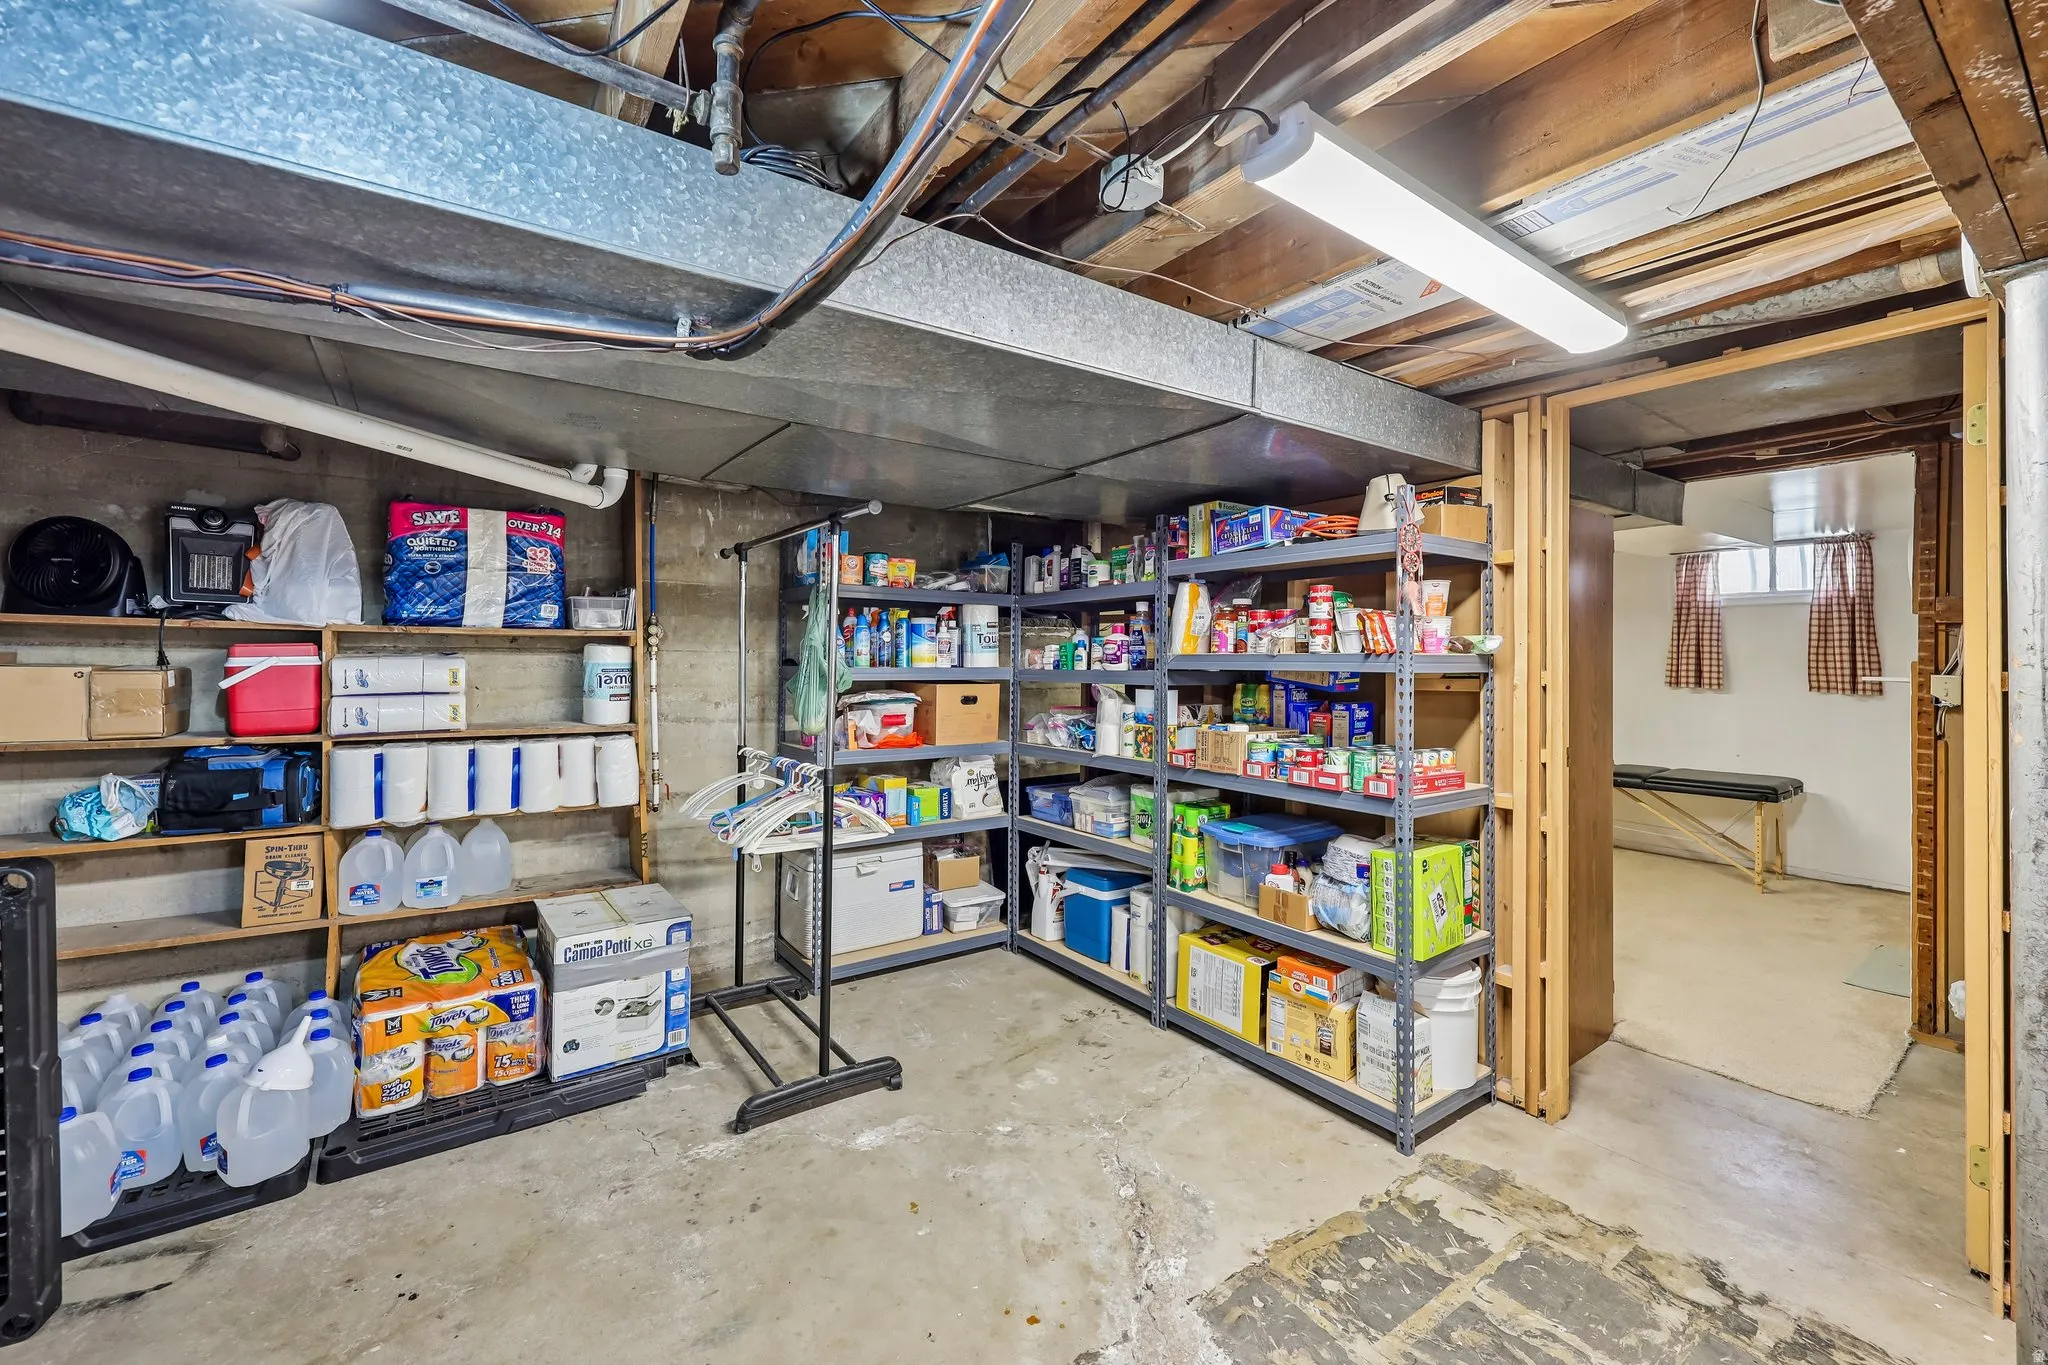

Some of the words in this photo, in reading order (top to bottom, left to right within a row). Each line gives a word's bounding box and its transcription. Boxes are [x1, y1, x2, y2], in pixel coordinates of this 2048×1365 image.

[411, 509, 461, 526] SAVE
[507, 519, 540, 533] OVER
[406, 536, 458, 548] QUILTED
[412, 545, 453, 553] NORTHERN
[528, 547, 549, 561] 32
[597, 673, 632, 689] owel
[1291, 690, 1308, 701] Ziploc
[1355, 709, 1369, 719] Ziploc
[265, 844, 308, 854] SPIN-THRU
[563, 944, 604, 964] Campa
[605, 936, 632, 957] Potti
[634, 938, 653, 951] XG
[510, 993, 530, 1004] THICK
[511, 1007, 530, 1016] LASTING
[516, 1001, 530, 1010] LONG
[429, 1008, 467, 1030] Towels
[382, 1078, 400, 1090] OVER
[382, 1080, 411, 1097] 2200
[381, 1088, 410, 1103] SHEETS
[121, 1157, 138, 1166] TER
